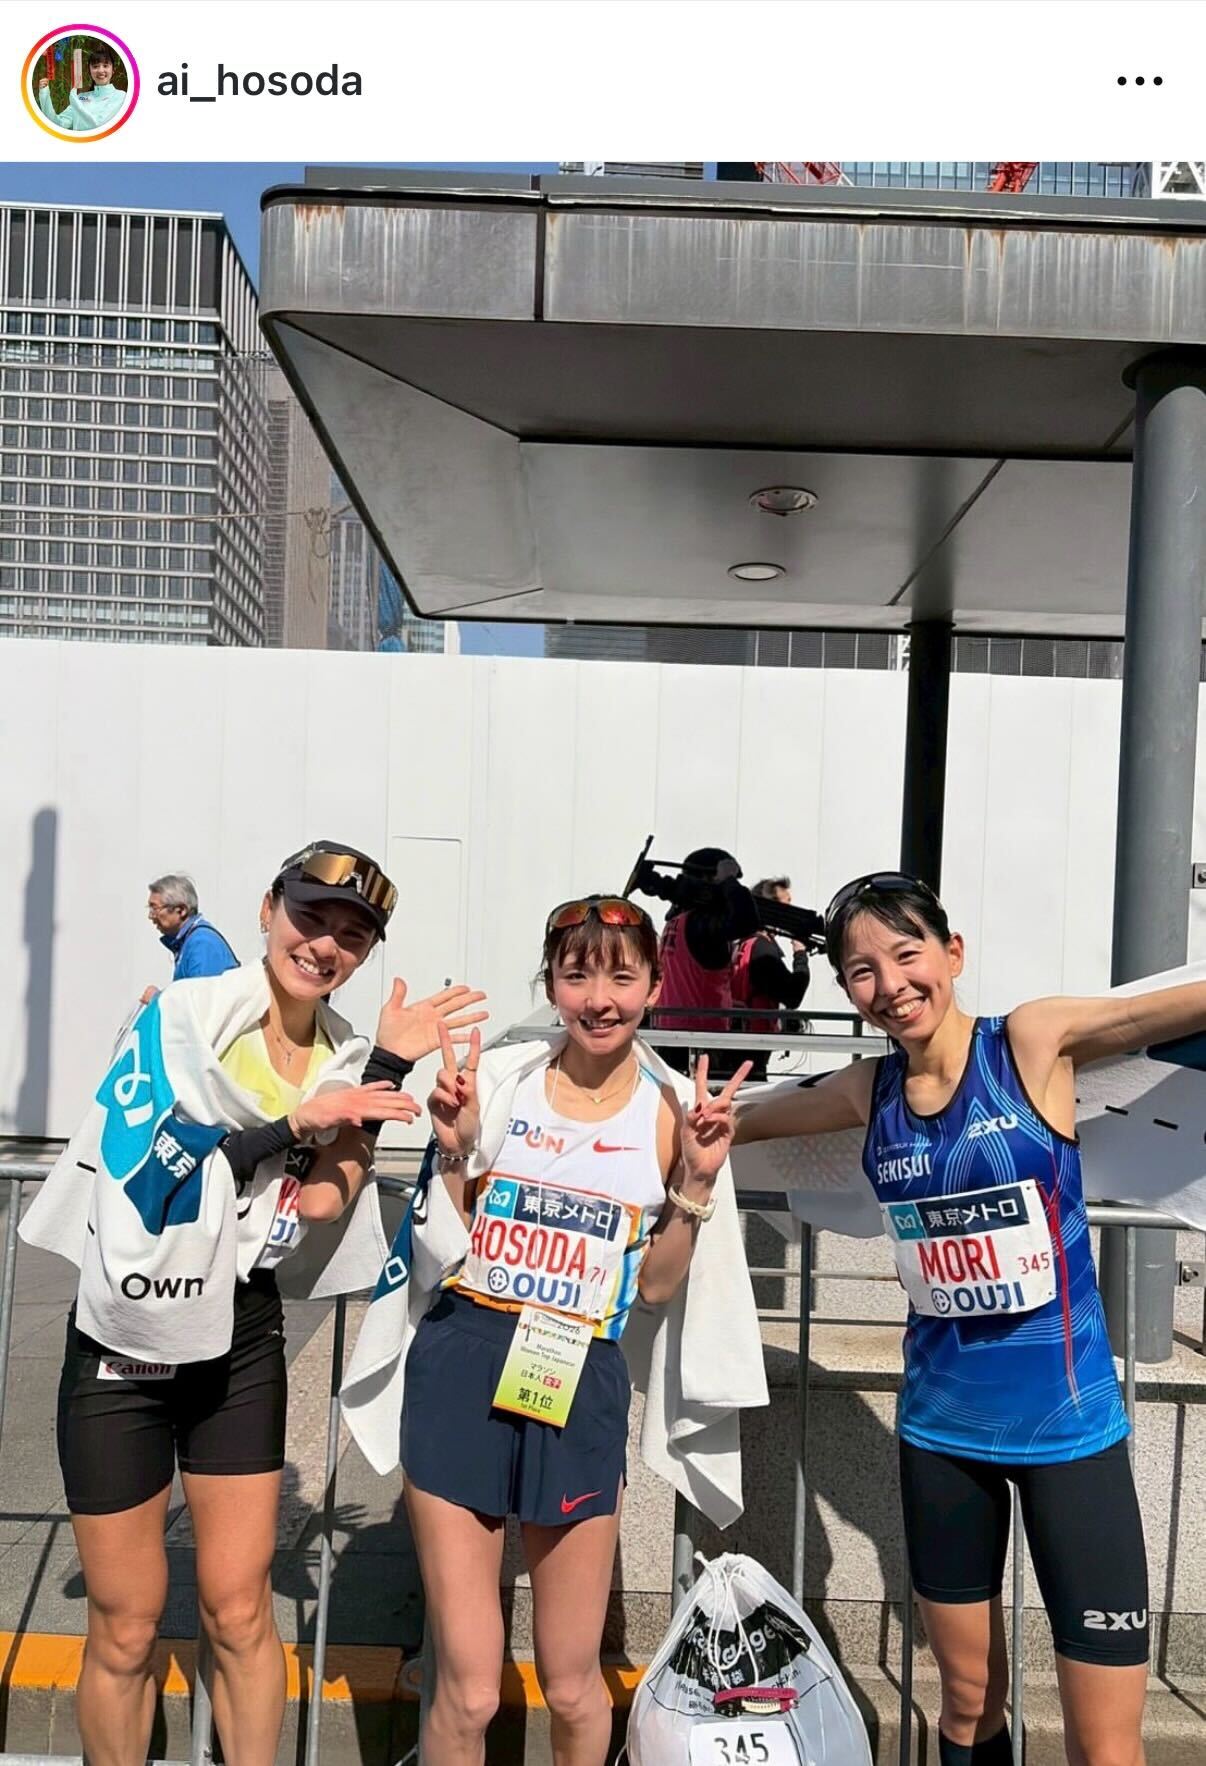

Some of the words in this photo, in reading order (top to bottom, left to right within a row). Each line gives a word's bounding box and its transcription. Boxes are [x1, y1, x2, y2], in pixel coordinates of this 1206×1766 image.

[968, 1113, 1019, 1139] 2XU
[877, 1153, 931, 1184] SEKISUI
[522, 1194, 614, 1231] 東京メトロ
[926, 1198, 1018, 1228] 東京メトロ
[471, 1215, 587, 1281] HOSODA
[917, 1235, 1001, 1284] MORI
[589, 1266, 607, 1286] 71
[1018, 1252, 1050, 1275] 345
[121, 1272, 204, 1300] Own
[513, 1272, 581, 1308] OUJI
[953, 1282, 1025, 1311] OUJI
[105, 1361, 172, 1376] Canon
[517, 1387, 554, 1410] 第1位
[1083, 1608, 1147, 1631] 2XU
[713, 1732, 769, 1766] 345
